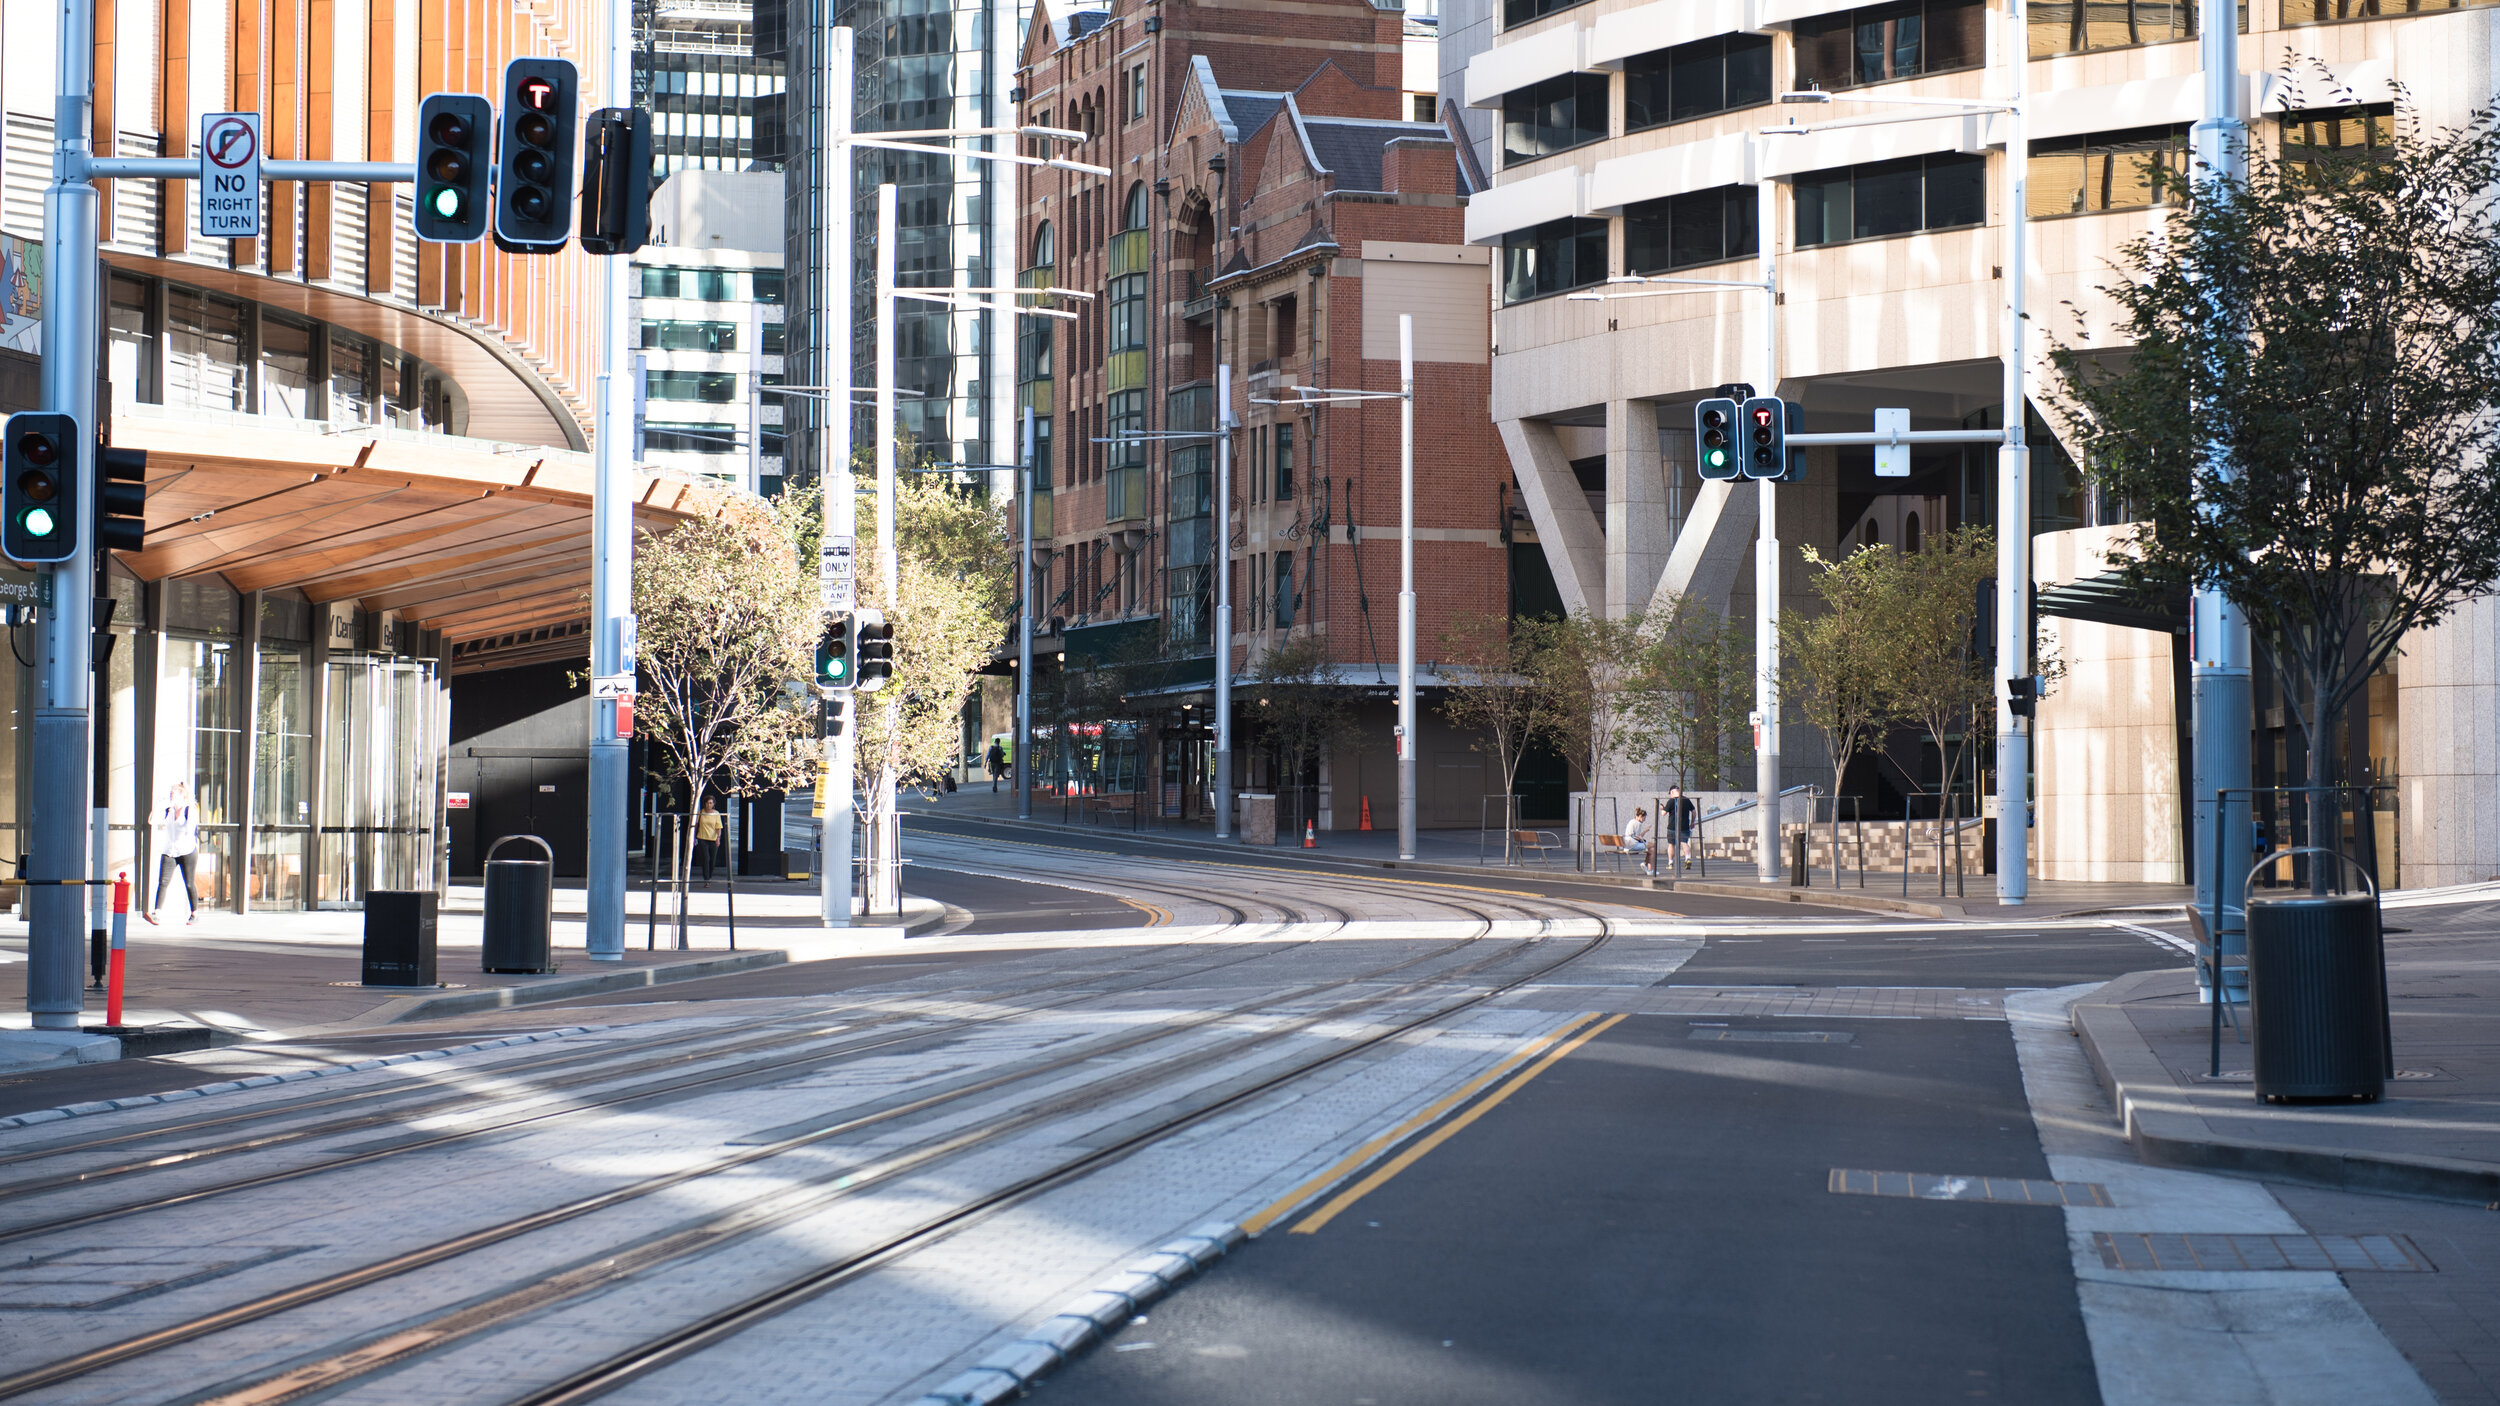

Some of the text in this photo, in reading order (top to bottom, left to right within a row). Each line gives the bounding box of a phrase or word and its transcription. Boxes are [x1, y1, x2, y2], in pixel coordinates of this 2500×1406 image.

[529, 84, 550, 108] T
[215, 174, 245, 192] NO
[207, 198, 252, 211] RIGHT
[209, 216, 251, 228] TURN
[1756, 411, 1770, 426] T
[825, 562, 848, 572] ONLY
[29, 581, 38, 598] St
[625, 621, 632, 643] P
